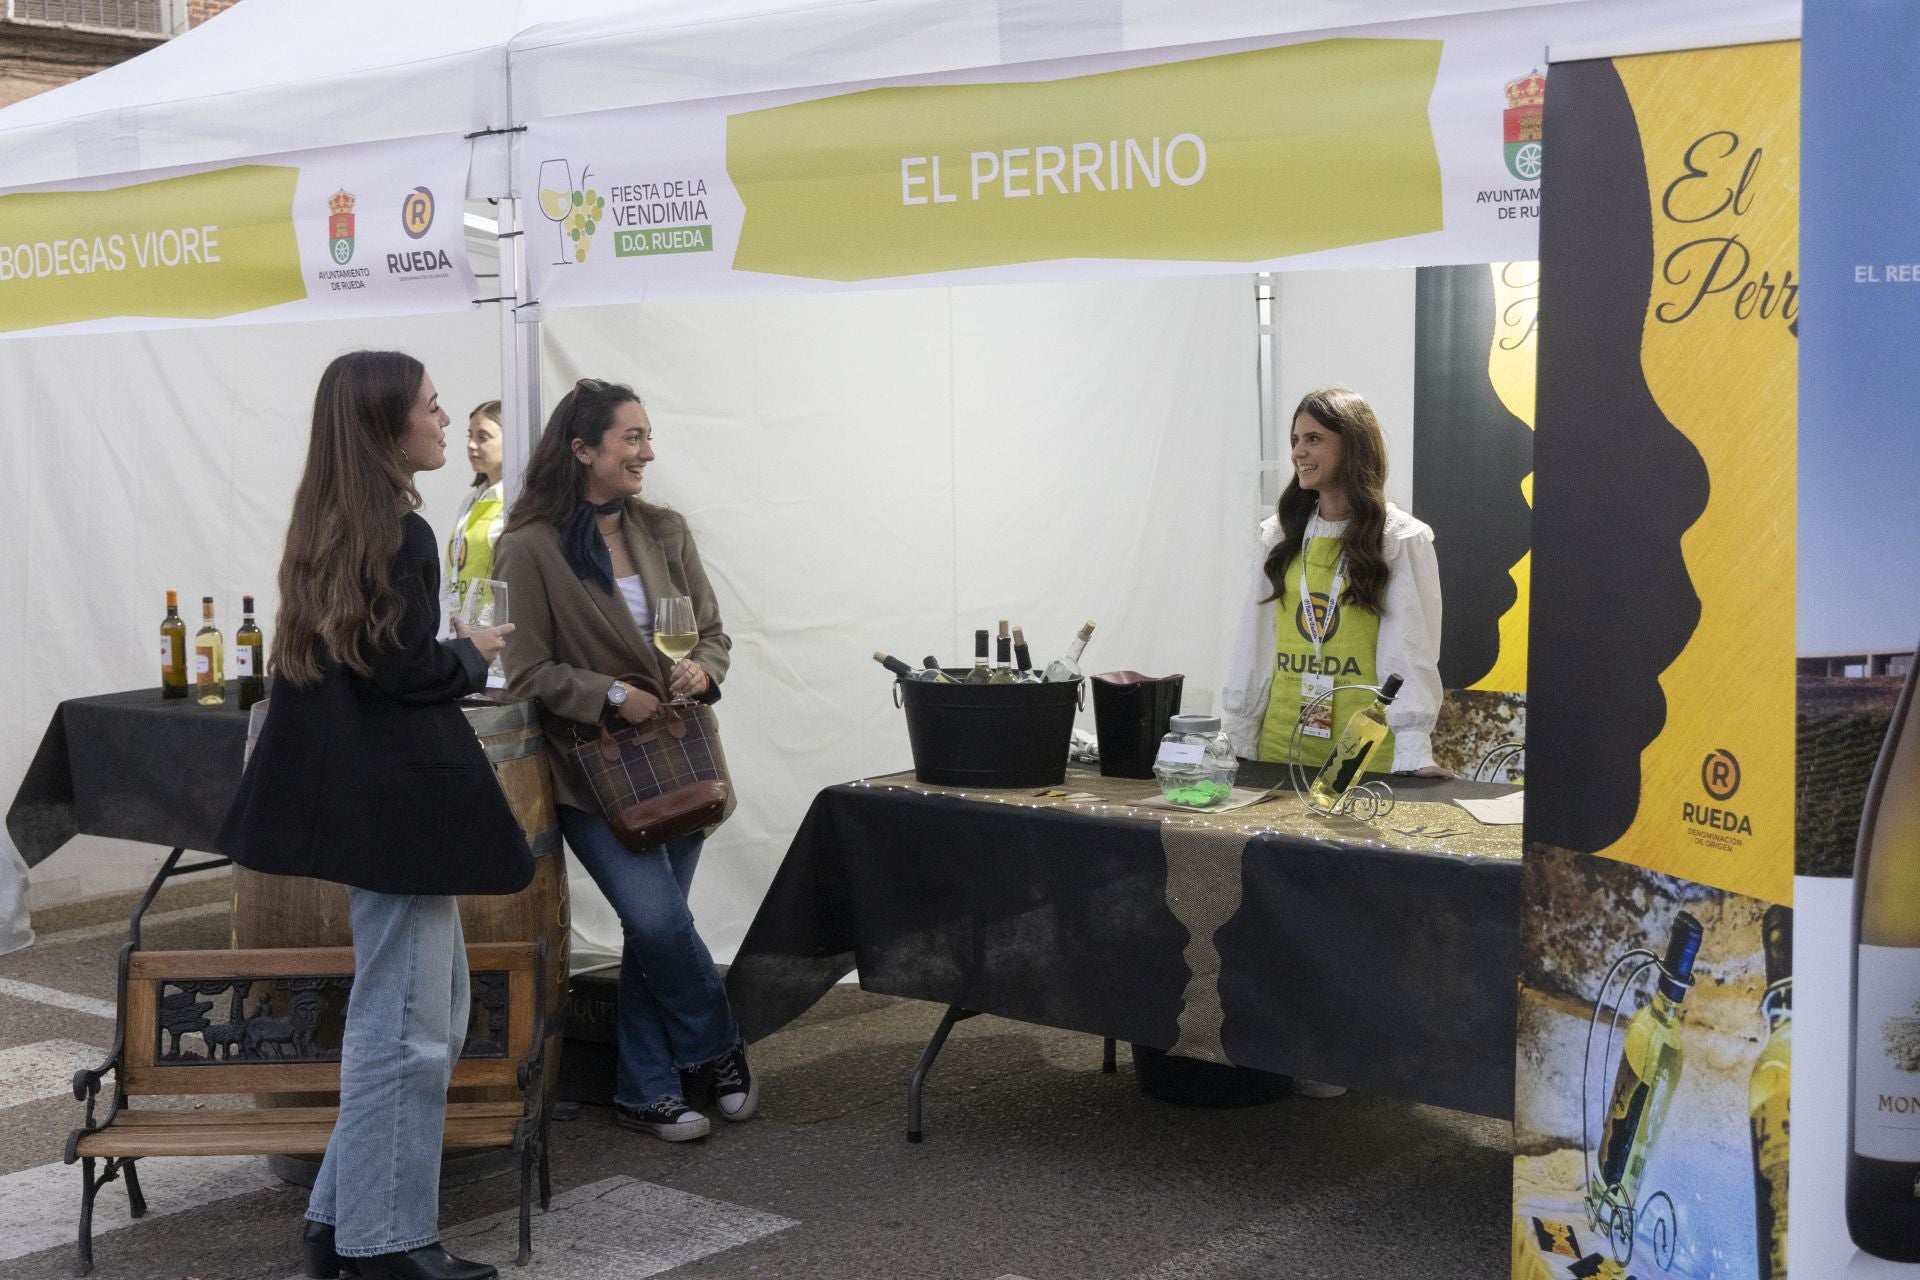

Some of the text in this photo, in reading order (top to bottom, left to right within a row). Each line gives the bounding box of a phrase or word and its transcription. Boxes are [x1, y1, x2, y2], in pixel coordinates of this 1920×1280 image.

[901, 132, 1207, 206] EL PERRINO
[1662, 130, 1763, 223] El
[611, 178, 708, 203] FIESTA DE LA
[612, 199, 709, 227] VENDIMIA
[1498, 207, 1516, 220] DE
[0, 224, 221, 281] BODEGAS VIORE
[622, 229, 705, 252] D.O. RUEDA
[318, 267, 370, 281] AYUNTAMIENTO
[386, 249, 453, 274] RUEDA
[1854, 265, 1880, 283] EL
[330, 280, 367, 291] DE RUEDA
[1277, 651, 1361, 677] RUEDA
[1682, 801, 1753, 837] RUEDA
[1705, 839, 1733, 853] ORIGEN
